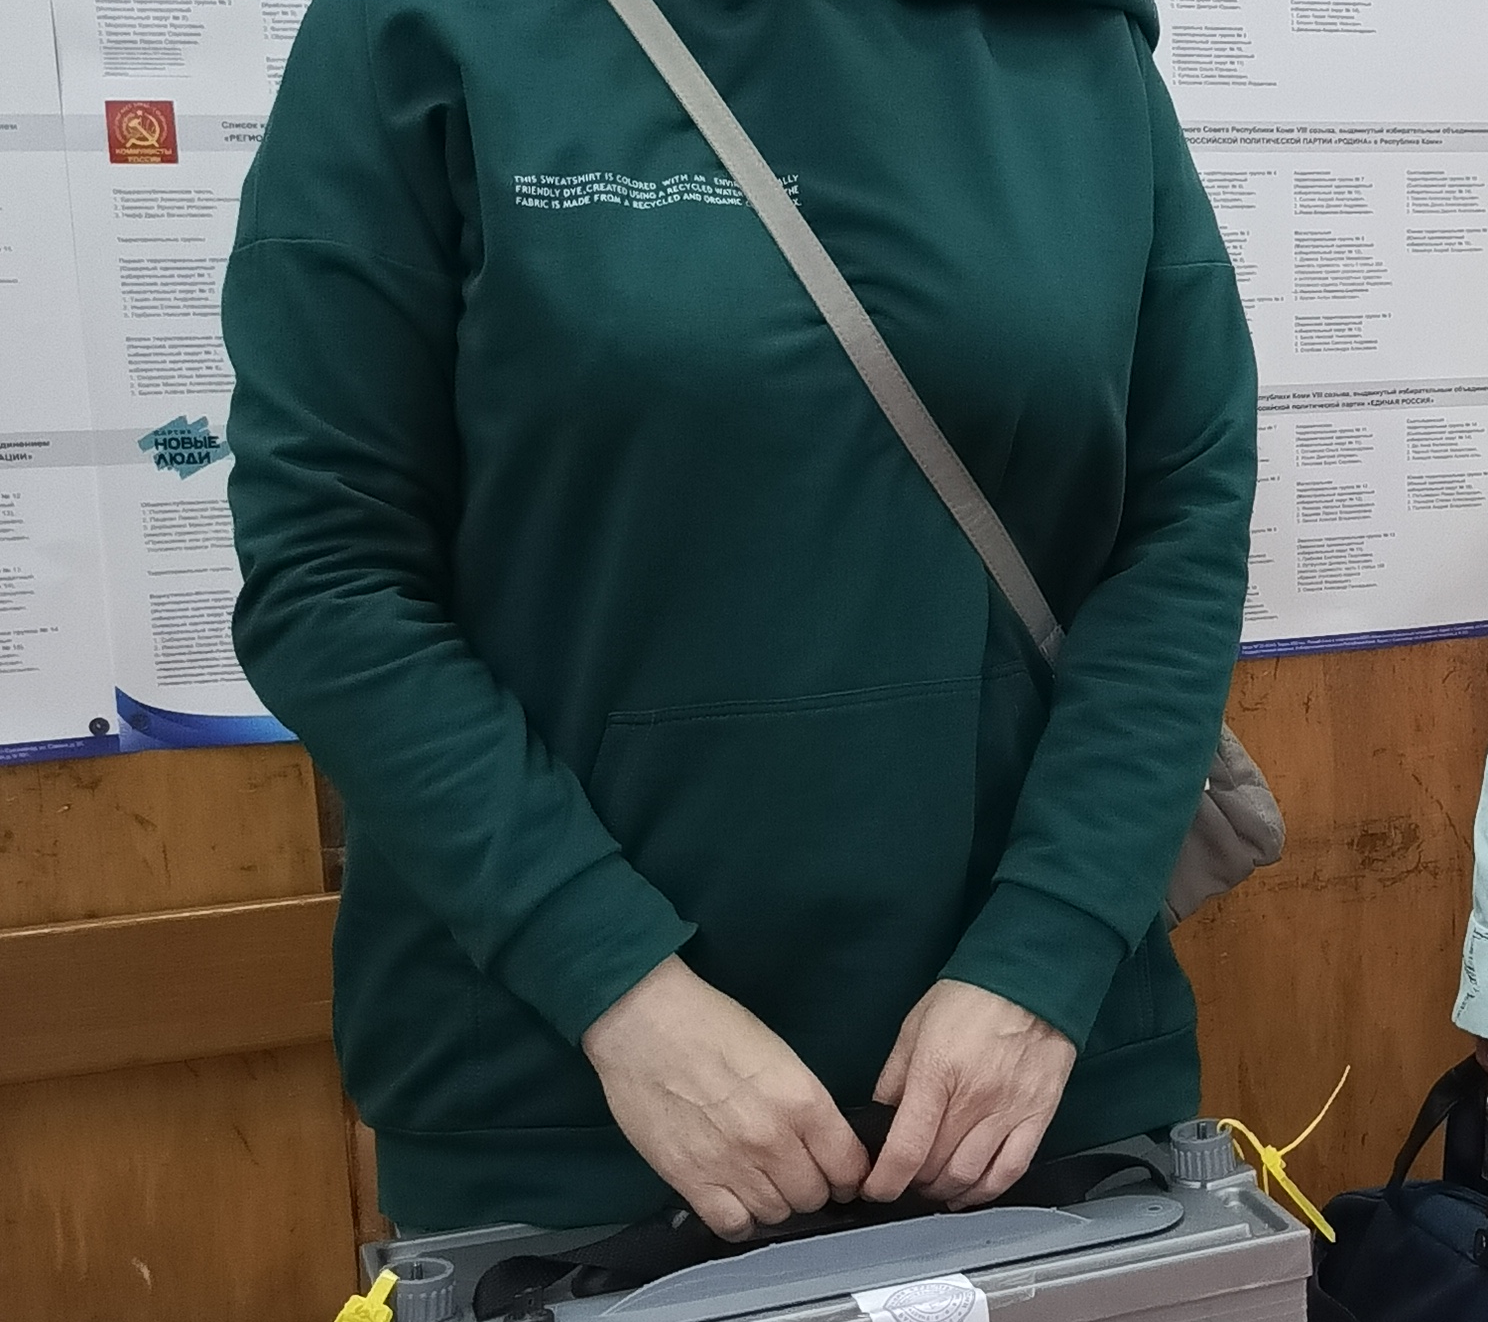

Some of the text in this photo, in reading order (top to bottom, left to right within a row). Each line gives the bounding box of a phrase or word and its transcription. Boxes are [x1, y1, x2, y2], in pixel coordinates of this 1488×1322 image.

[514, 175, 537, 184] THIS
[540, 172, 601, 186] SWEATSHIRT
[605, 172, 614, 181] IS
[616, 174, 656, 190] COLORED
[662, 174, 688, 187] WITH
[515, 185, 560, 197] FRIENDLY
[629, 190, 656, 200] USING
[658, 190, 666, 198] A
[667, 183, 713, 195] RECYCLED
[515, 196, 549, 209] FABRIC
[551, 200, 560, 209] IS
[563, 196, 591, 208] MADE
[593, 194, 621, 204] FROM
[632, 194, 681, 210] RECYCLED
[683, 193, 702, 202] AND
[154, 435, 221, 451] НОВЫЕ
